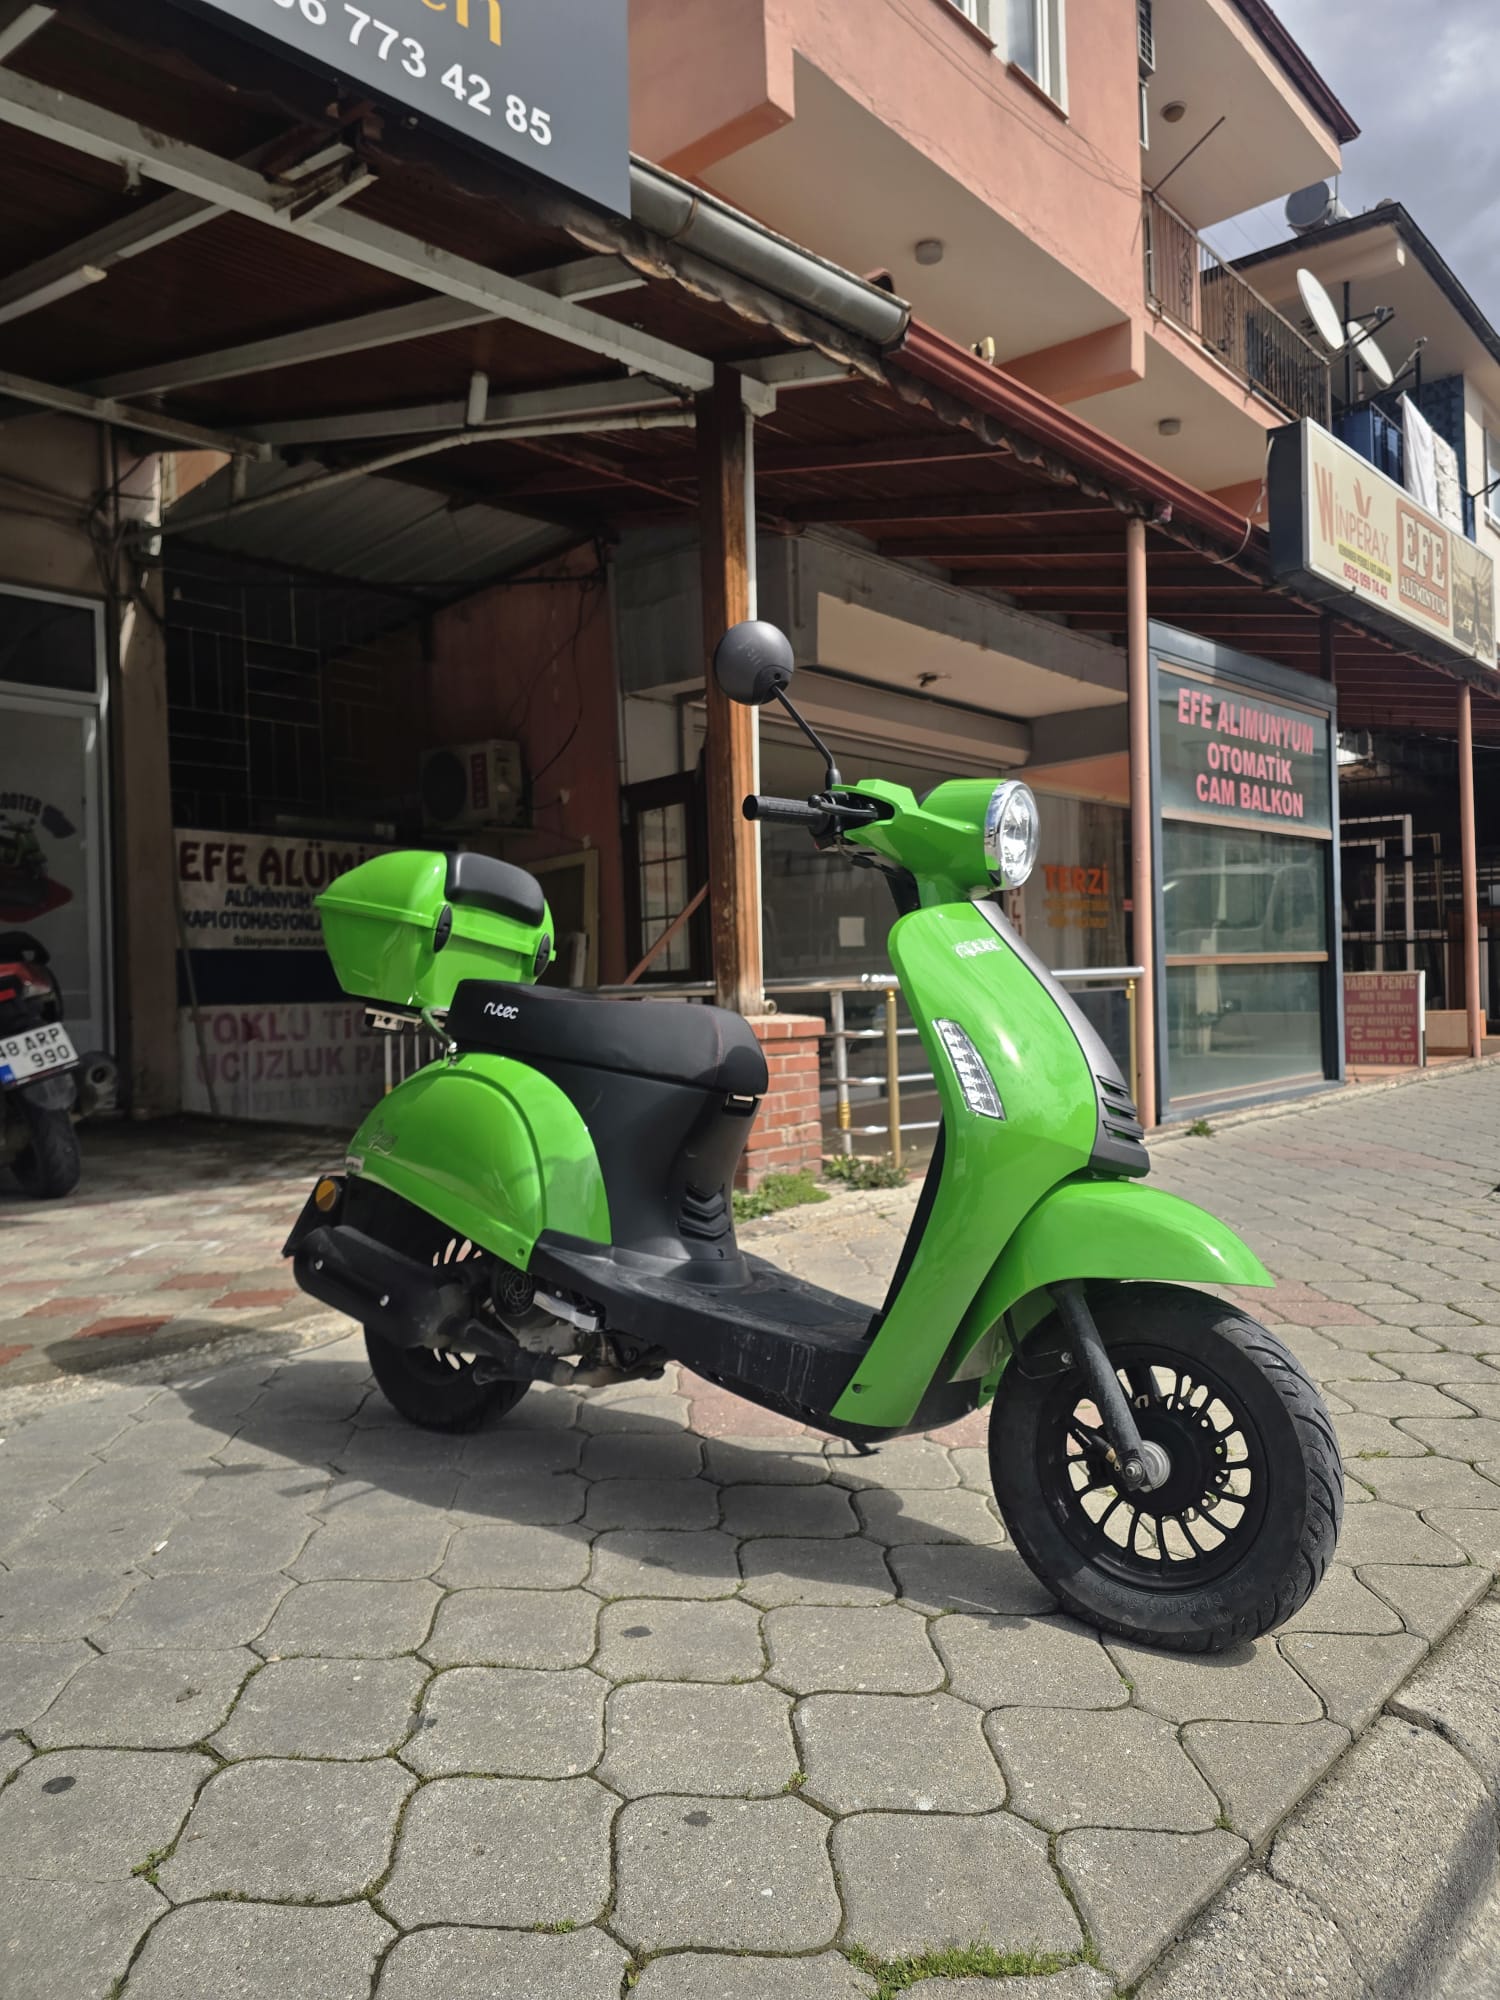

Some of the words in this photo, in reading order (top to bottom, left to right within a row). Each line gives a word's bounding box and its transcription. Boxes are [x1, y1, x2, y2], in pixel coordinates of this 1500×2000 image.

[344, 3, 427, 78] 773
[441, 63, 491, 116] 42
[505, 94, 552, 146] 85
[1400, 511, 1445, 588] EFE
[1178, 688, 1212, 729] EFE
[1207, 742, 1293, 785] OTOMATİK
[1196, 774, 1235, 806] CAM
[1240, 782, 1303, 817] BALKON
[180, 841, 247, 884] EFE
[1042, 864, 1108, 895] TERZİ
[219, 910, 321, 930] OTOMASYONL
[31, 1045, 70, 1067] 990
